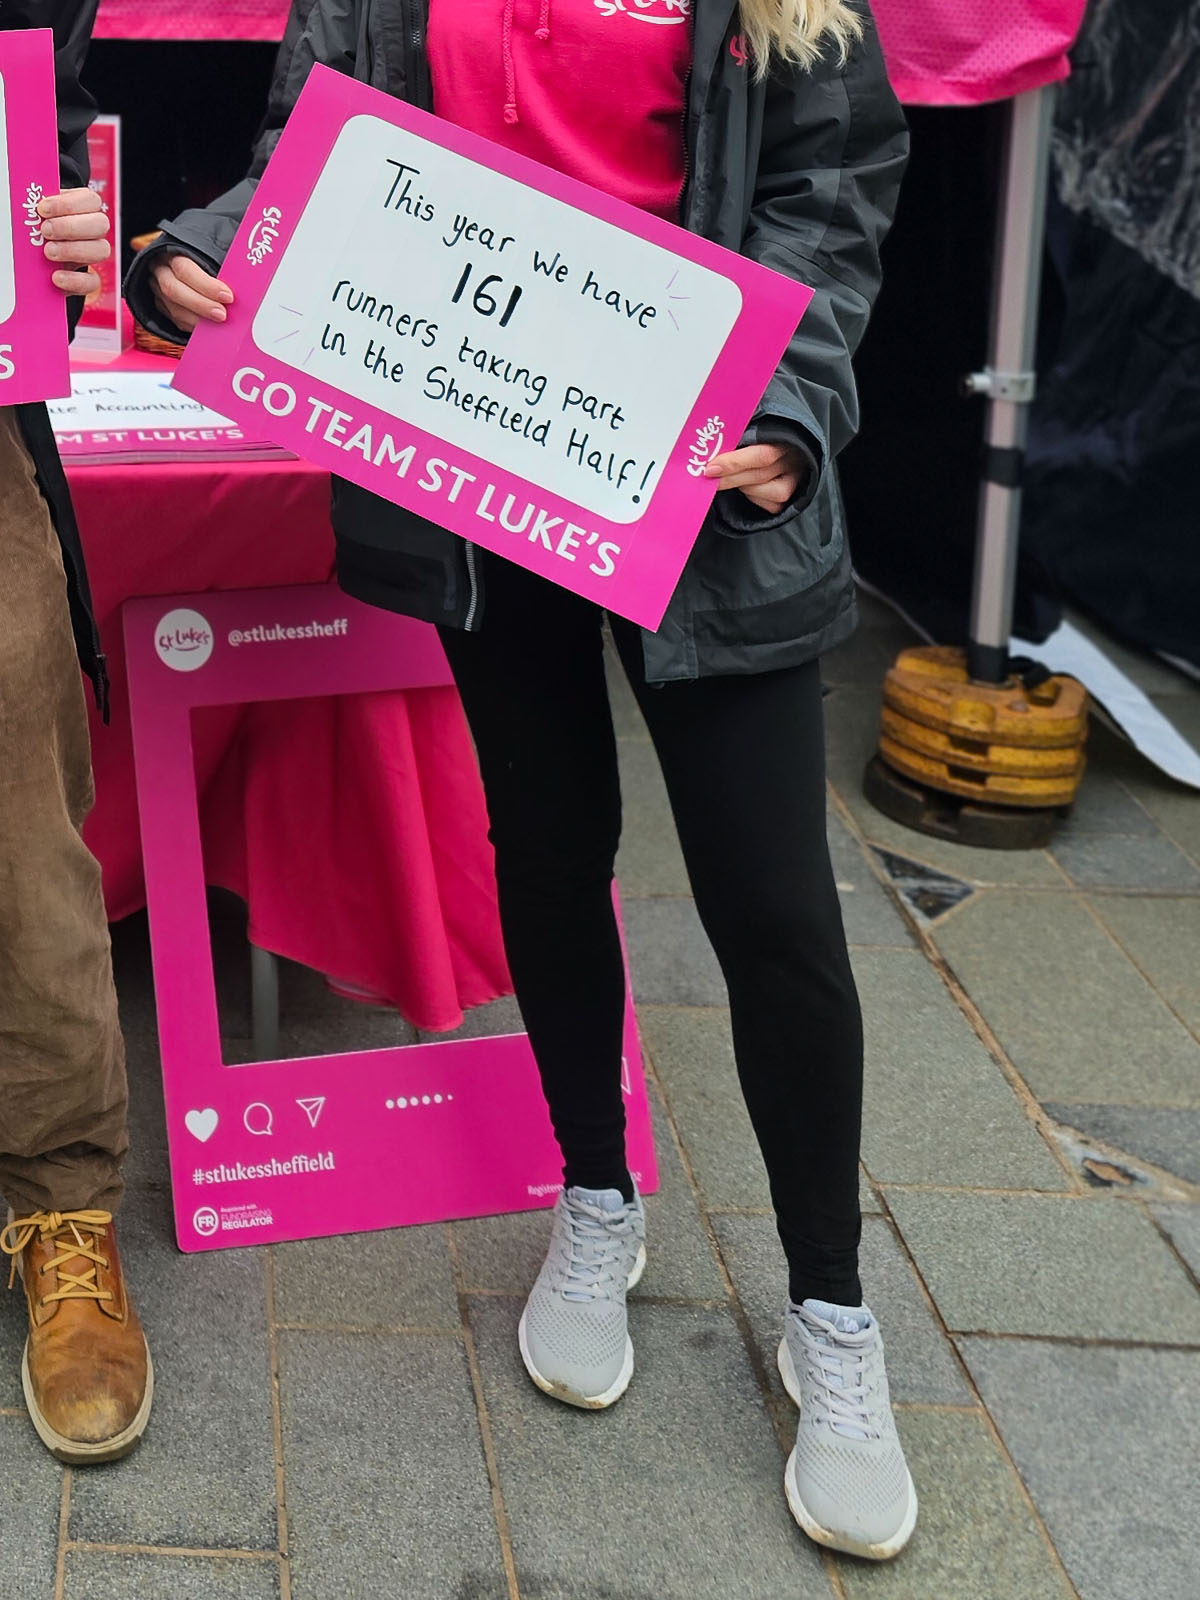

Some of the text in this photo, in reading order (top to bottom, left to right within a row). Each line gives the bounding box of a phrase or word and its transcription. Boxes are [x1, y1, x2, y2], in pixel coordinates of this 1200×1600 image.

[382, 158, 436, 224] This
[442, 211, 518, 252] year
[580, 270, 657, 330] have
[450, 262, 523, 328] 161
[332, 279, 626, 430] runners taking part
[91, 431, 128, 443] ST
[138, 427, 245, 442] LUKE'S
[363, 339, 404, 383] the
[423, 365, 551, 448] Sheffield
[566, 427, 657, 504] Half!
[231, 366, 621, 578] GO TEAM ST LUKE'S
[228, 618, 349, 647] @stlukessheff
[192, 1151, 336, 1186] #stlukessheffield
[222, 1215, 274, 1231] REGULATOR
